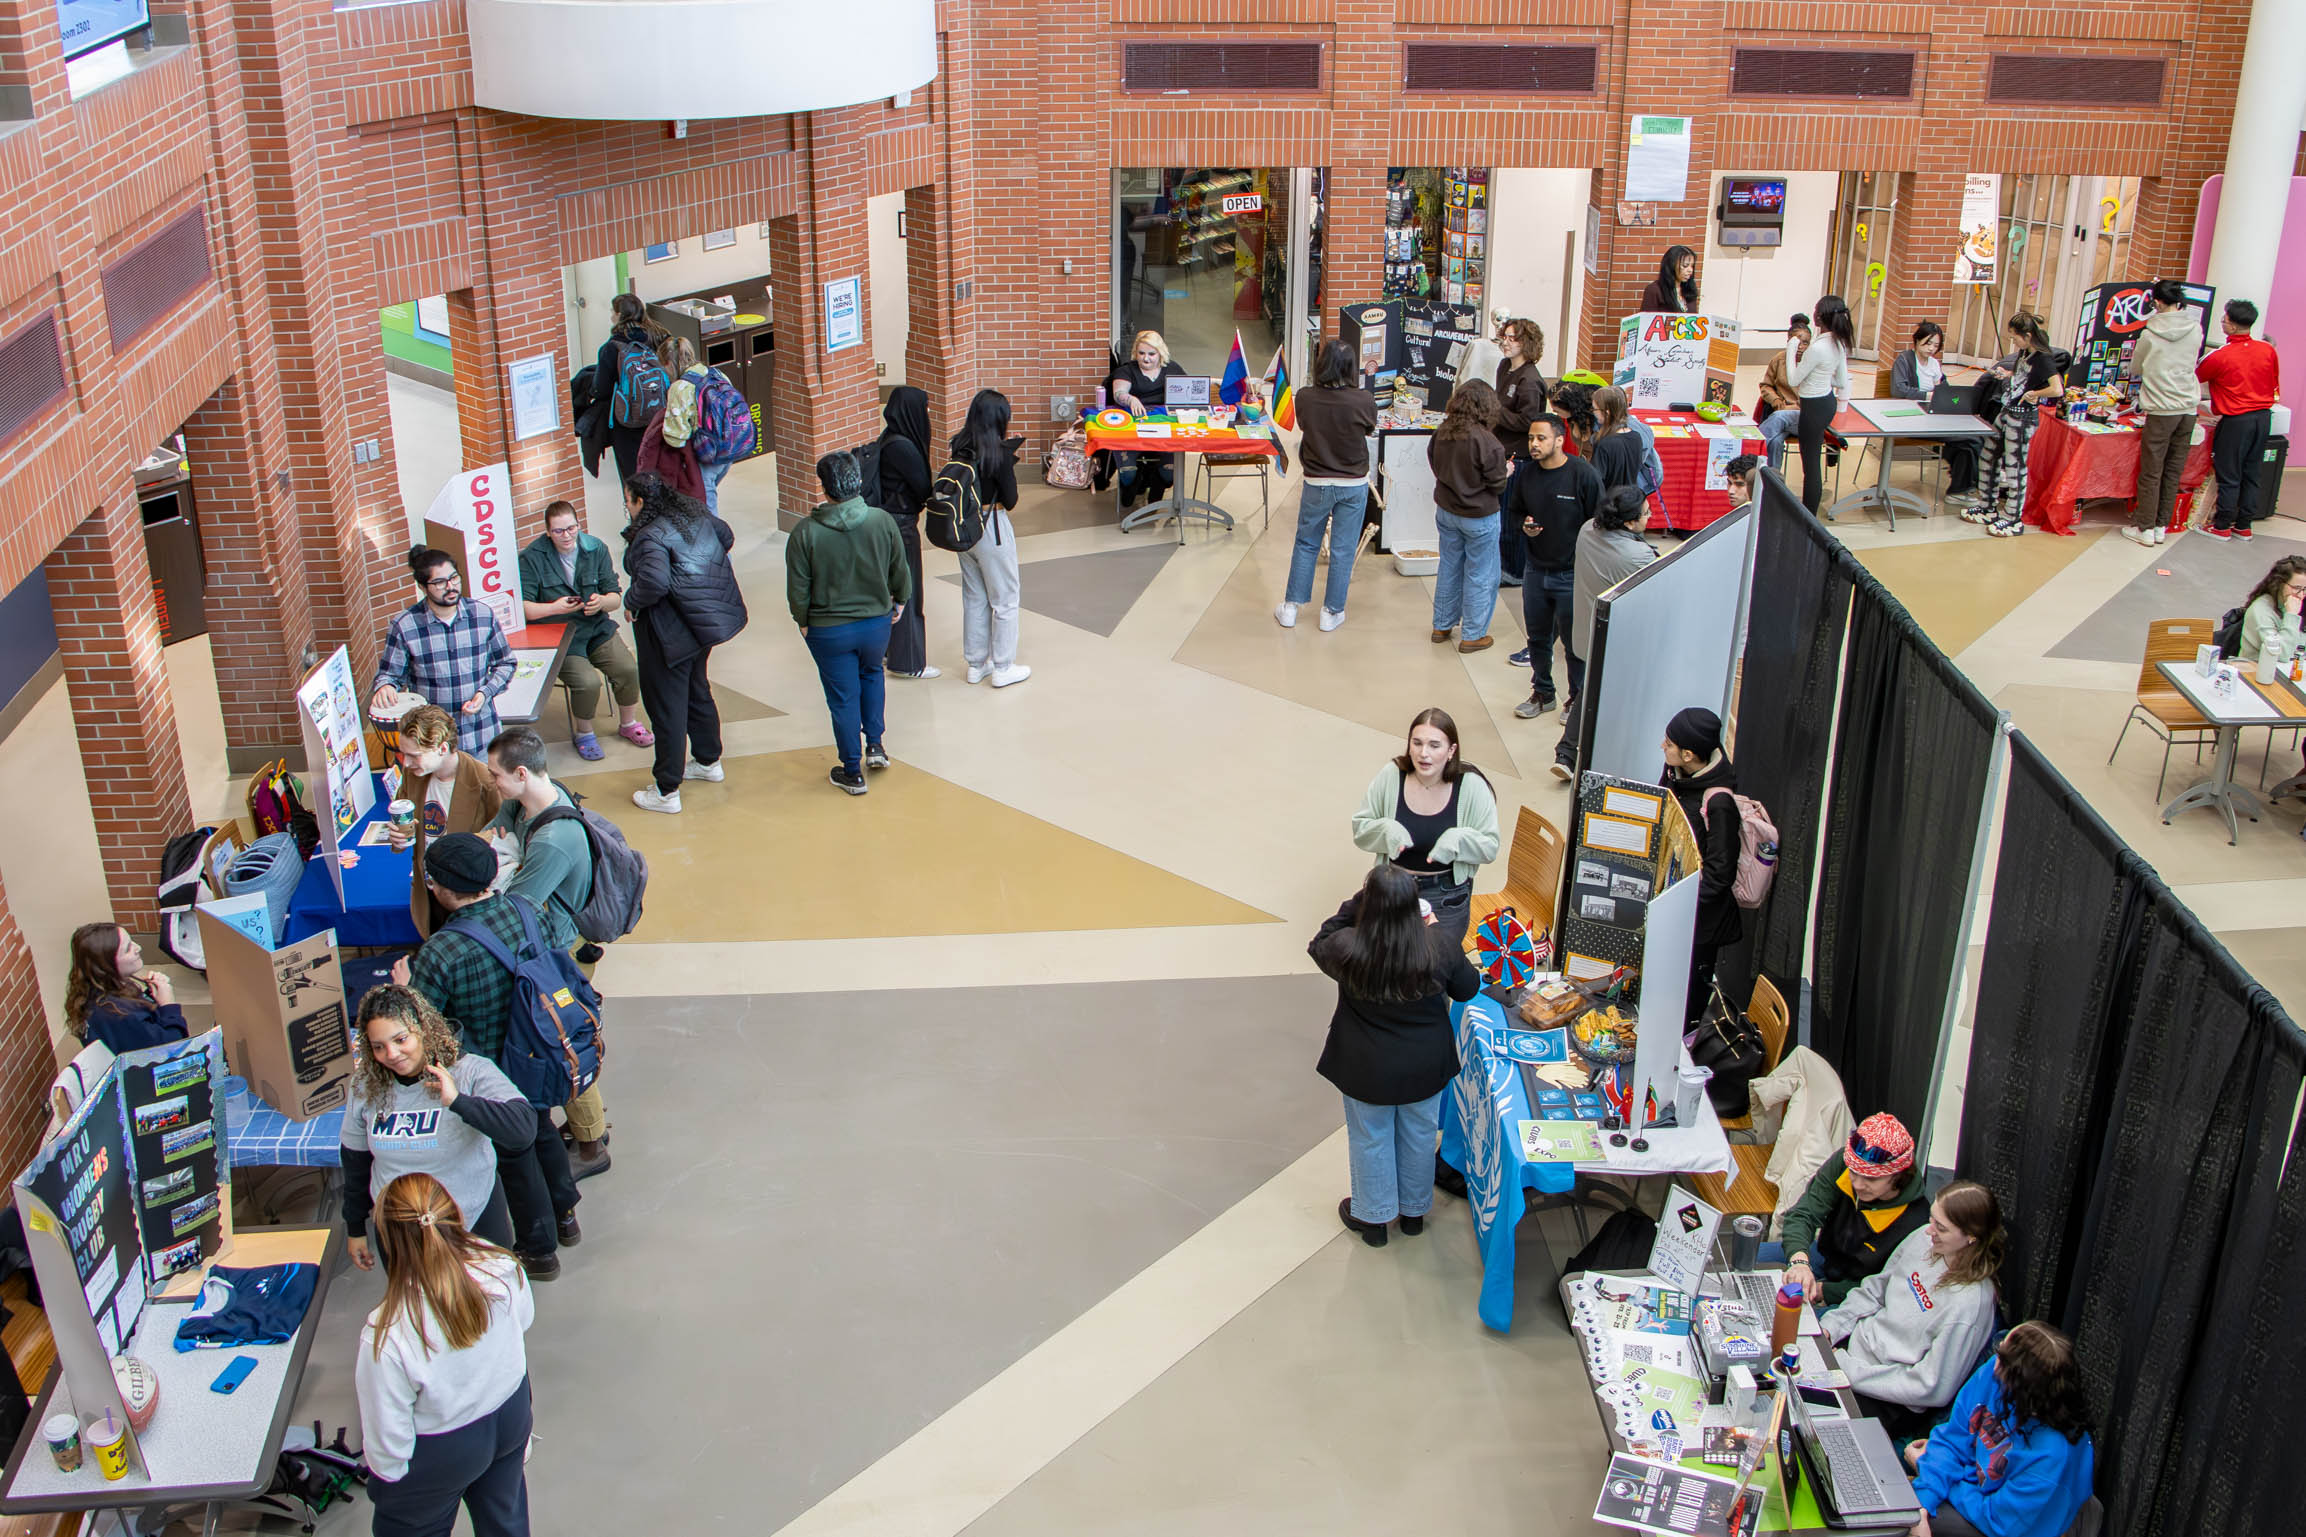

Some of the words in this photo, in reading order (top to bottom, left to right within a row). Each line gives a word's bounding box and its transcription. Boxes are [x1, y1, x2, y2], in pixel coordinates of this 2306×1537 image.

[1226, 197, 1258, 211] OPEN
[832, 293, 852, 303] WE'RE
[832, 300, 853, 310] HIRING
[1405, 334, 1432, 348] Cultural
[1643, 314, 1710, 342] AFCSS
[470, 474, 502, 593] CDSCC
[371, 1107, 442, 1139] MRU
[1527, 1124, 1541, 1145] CLUBS
[59, 1128, 91, 1183] MRU
[1533, 1147, 1557, 1160] EXPO
[60, 1145, 109, 1223] WOMENS
[70, 1186, 105, 1251] RUGBY
[76, 1224, 106, 1279] CLUB
[1662, 1227, 1706, 1257] Weekender
[1911, 1271, 1933, 1309] COSTCO
[1623, 1367, 1647, 1384] CLUBS
[1675, 1477, 1708, 1508] BOILER
[1667, 1504, 1701, 1532] ROOM
